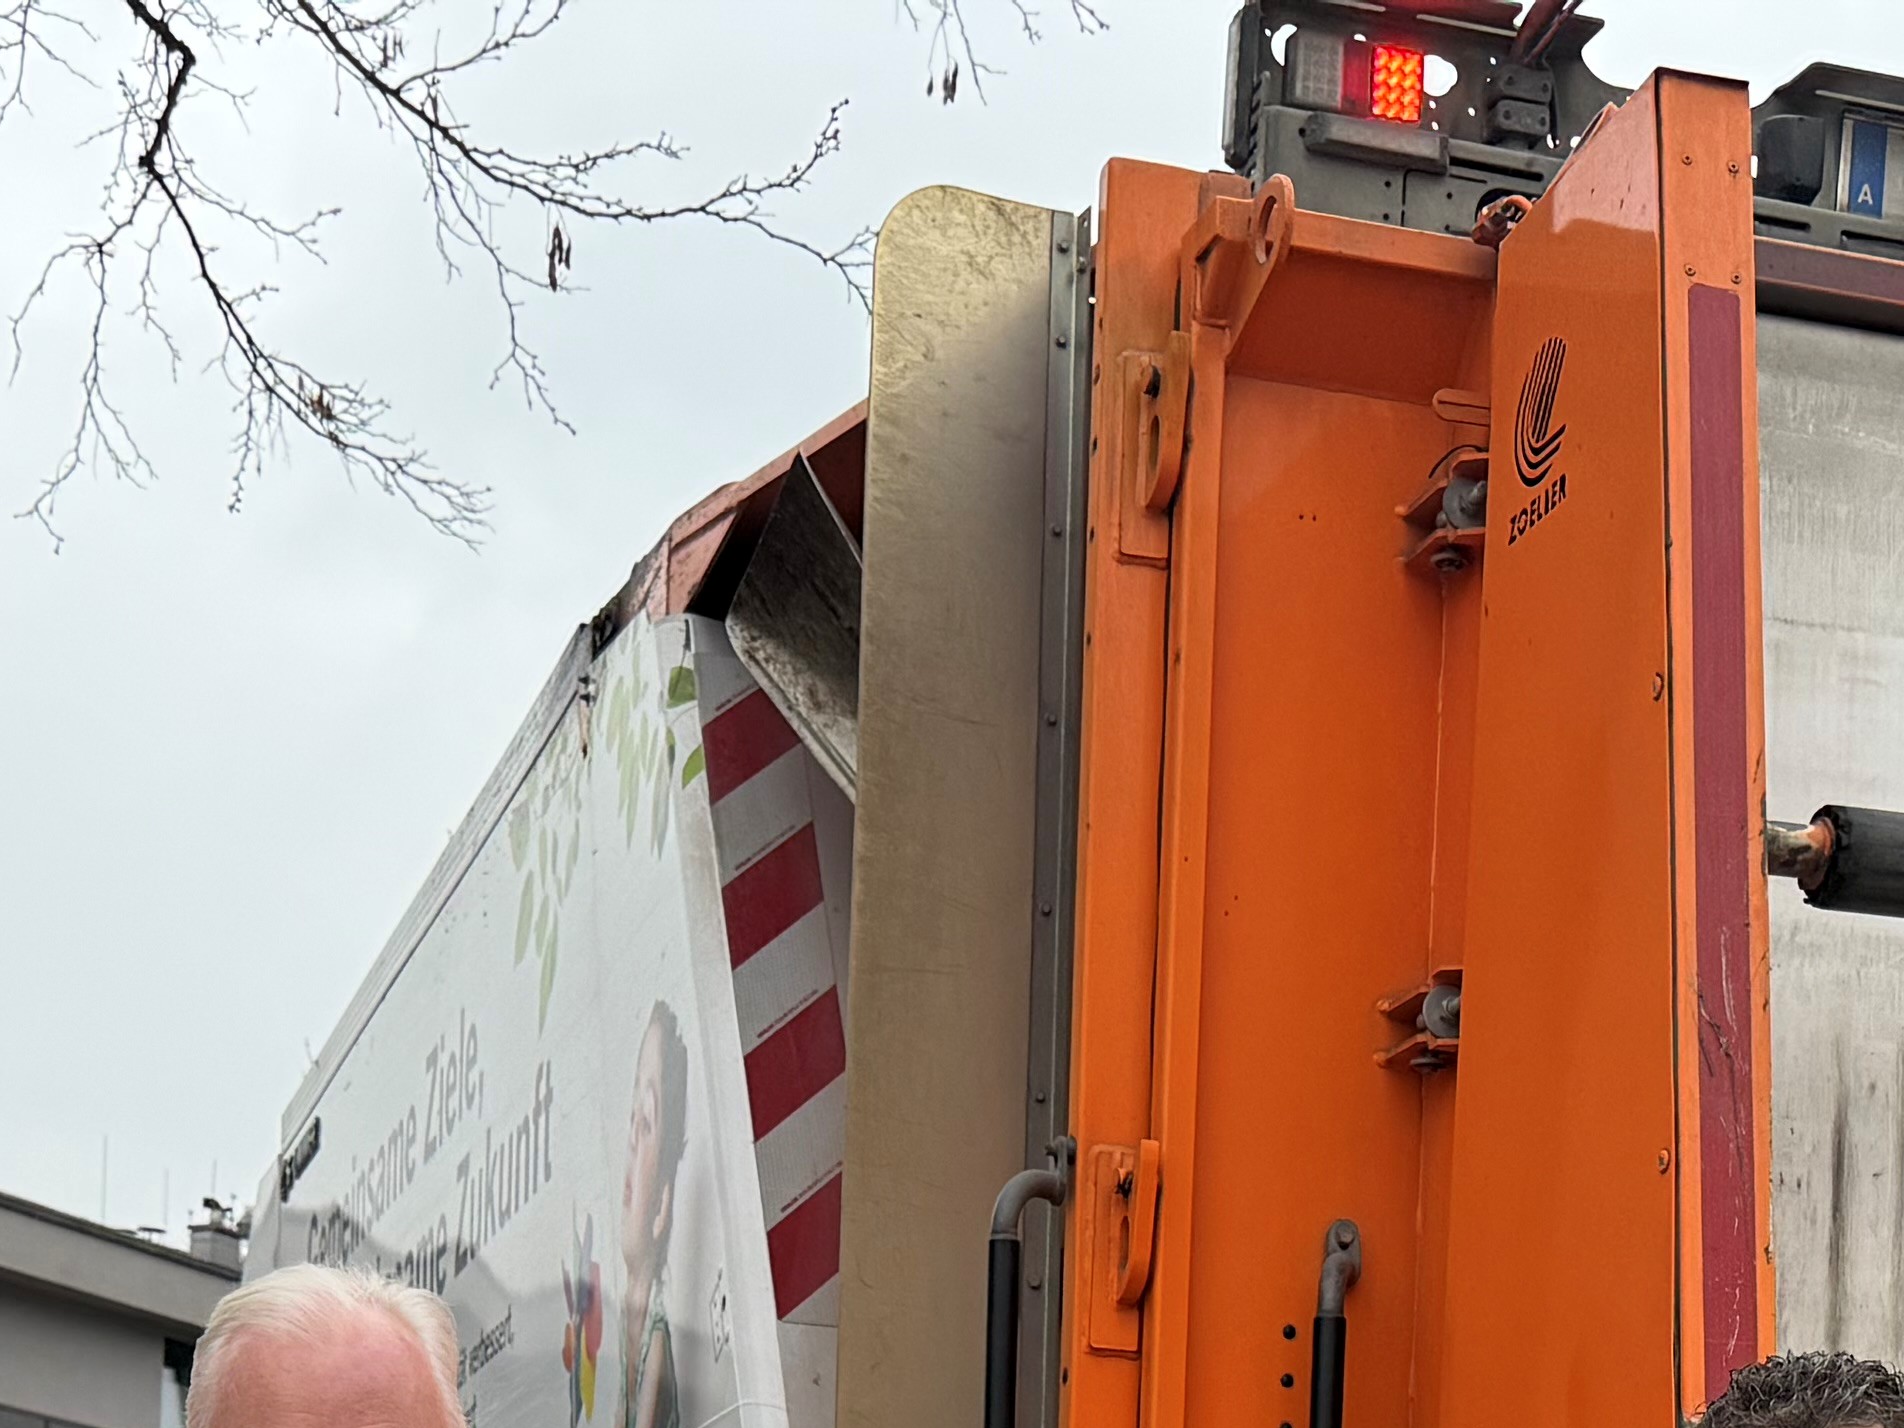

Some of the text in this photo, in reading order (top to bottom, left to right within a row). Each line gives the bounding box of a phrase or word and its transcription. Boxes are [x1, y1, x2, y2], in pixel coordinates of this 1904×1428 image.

[1856, 183, 1874, 206] A
[423, 1006, 485, 1166] Ziele,
[453, 1058, 554, 1279] Zukunft
